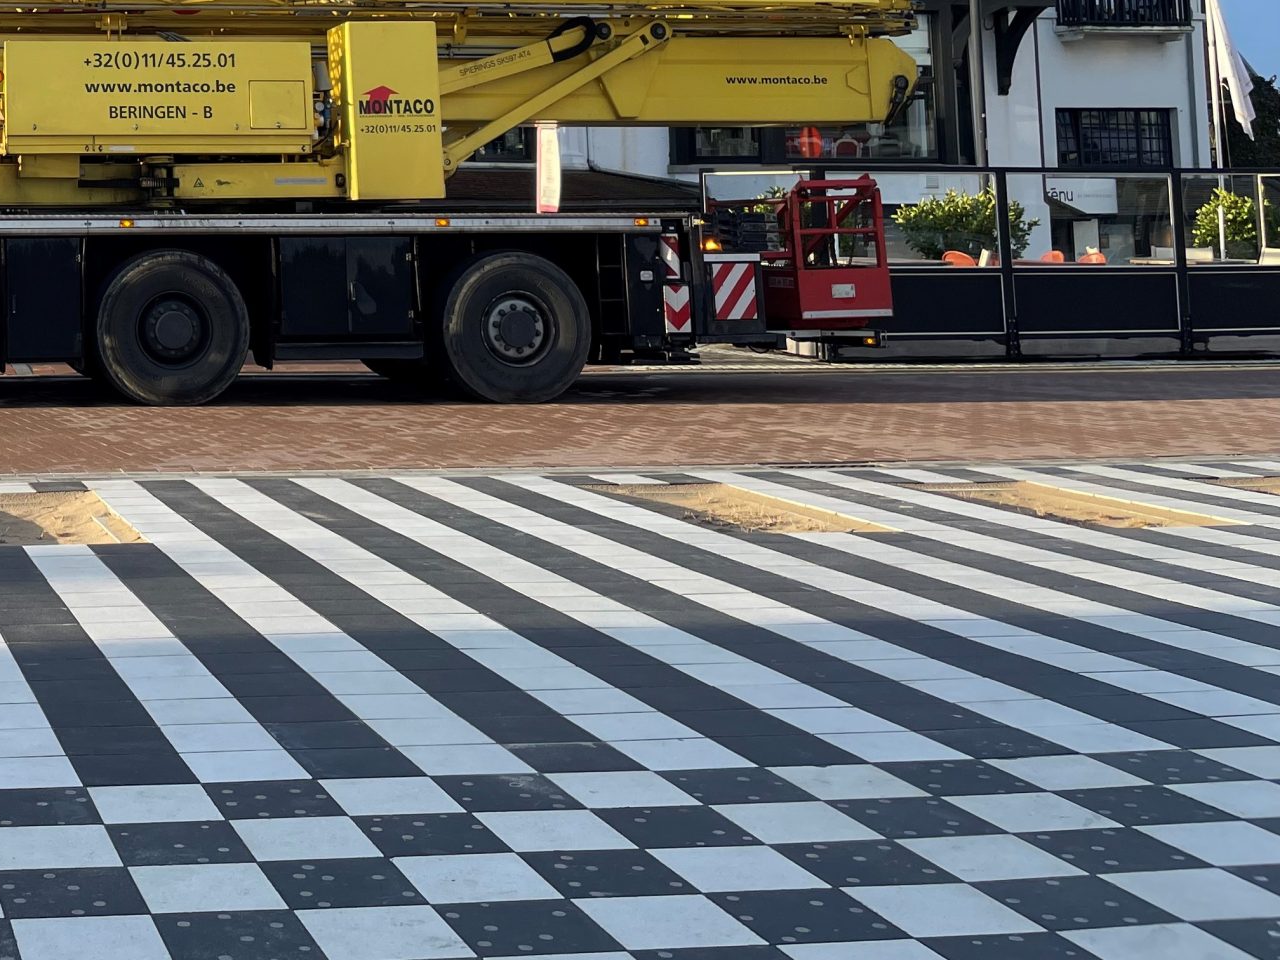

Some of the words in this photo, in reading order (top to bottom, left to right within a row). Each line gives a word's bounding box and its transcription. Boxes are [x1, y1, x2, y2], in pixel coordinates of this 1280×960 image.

[459, 60, 496, 76] SPIERINGS
[84, 79, 237, 93] www.montaco.be
[725, 75, 828, 85] www.montaco.be
[109, 105, 187, 119] BERINGEN
[203, 106, 213, 119] B
[358, 99, 435, 115] MONTACO
